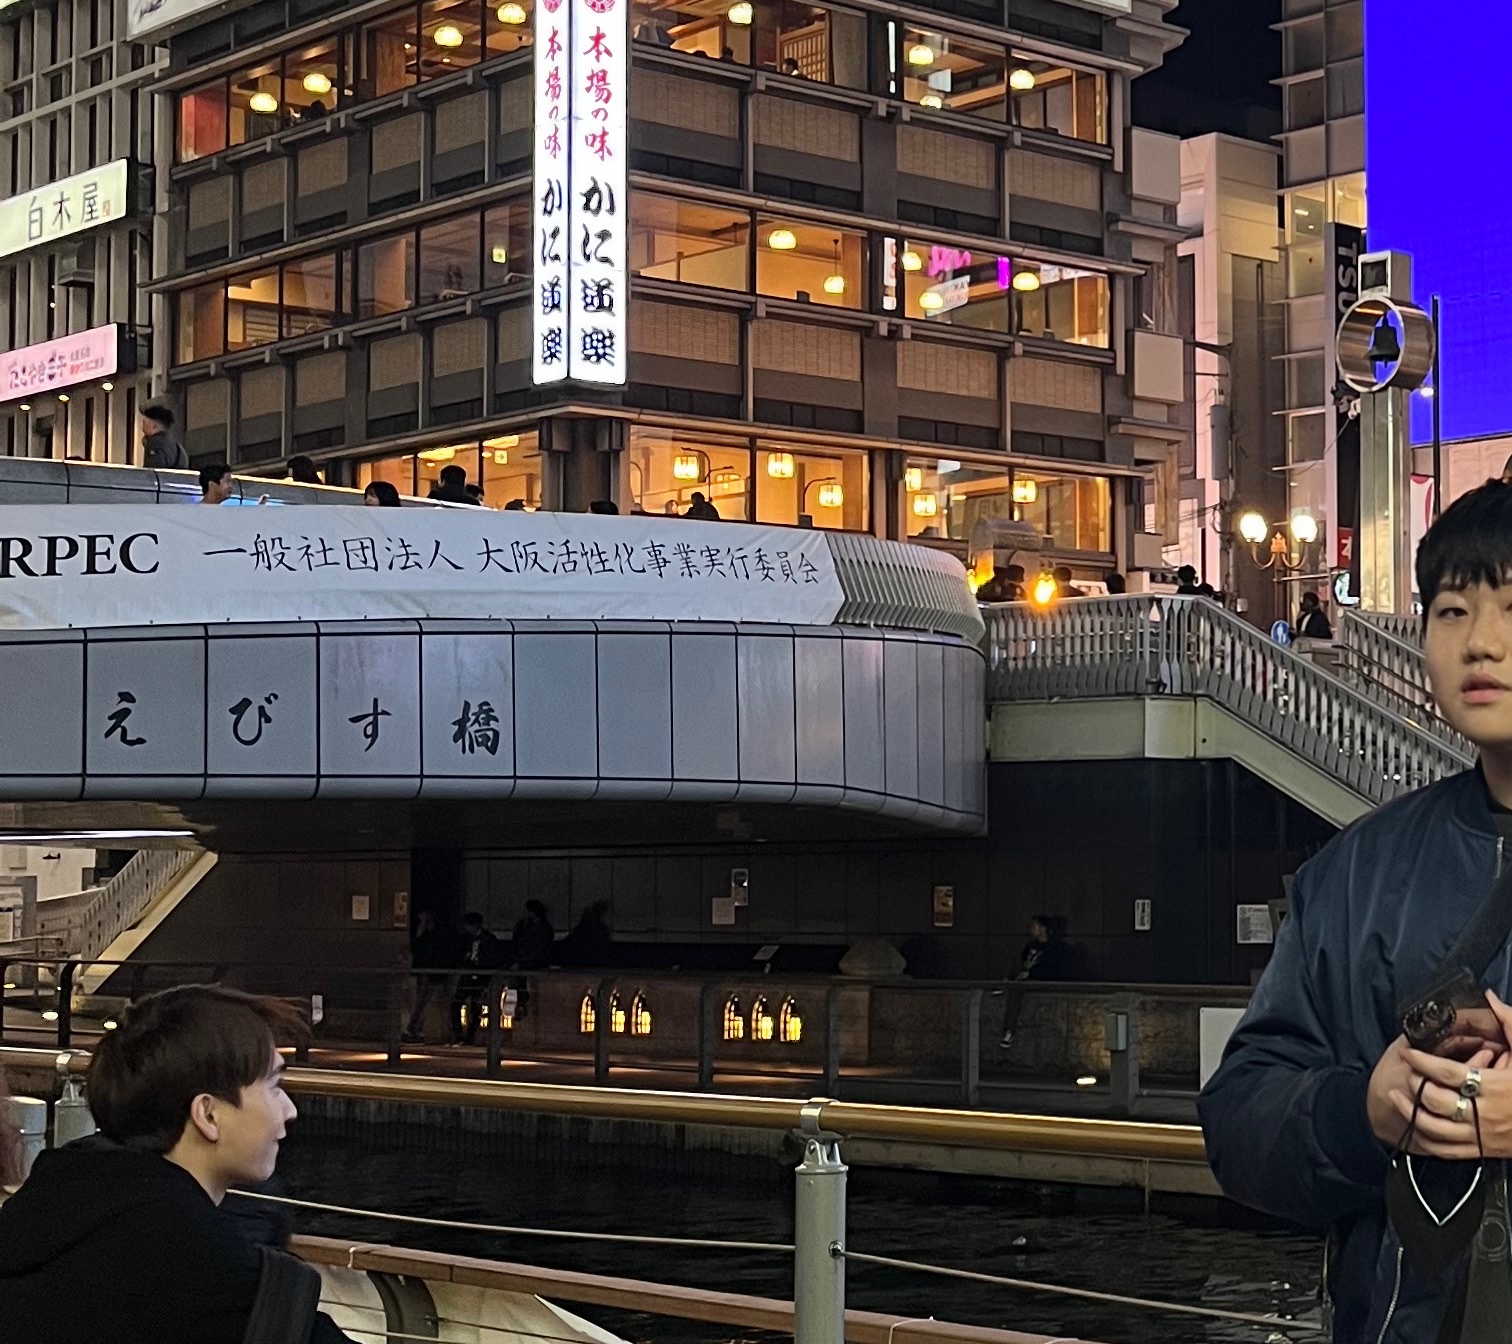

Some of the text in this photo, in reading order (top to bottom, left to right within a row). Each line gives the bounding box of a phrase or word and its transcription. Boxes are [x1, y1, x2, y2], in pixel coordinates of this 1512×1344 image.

[543, 25, 562, 161] 本場の味
[582, 24, 613, 163] 本場の味
[28, 183, 99, 242] 白木屋
[203, 533, 464, 573] 一般社団法人
[477, 536, 820, 585] 大阪活性化事業実行委員会
